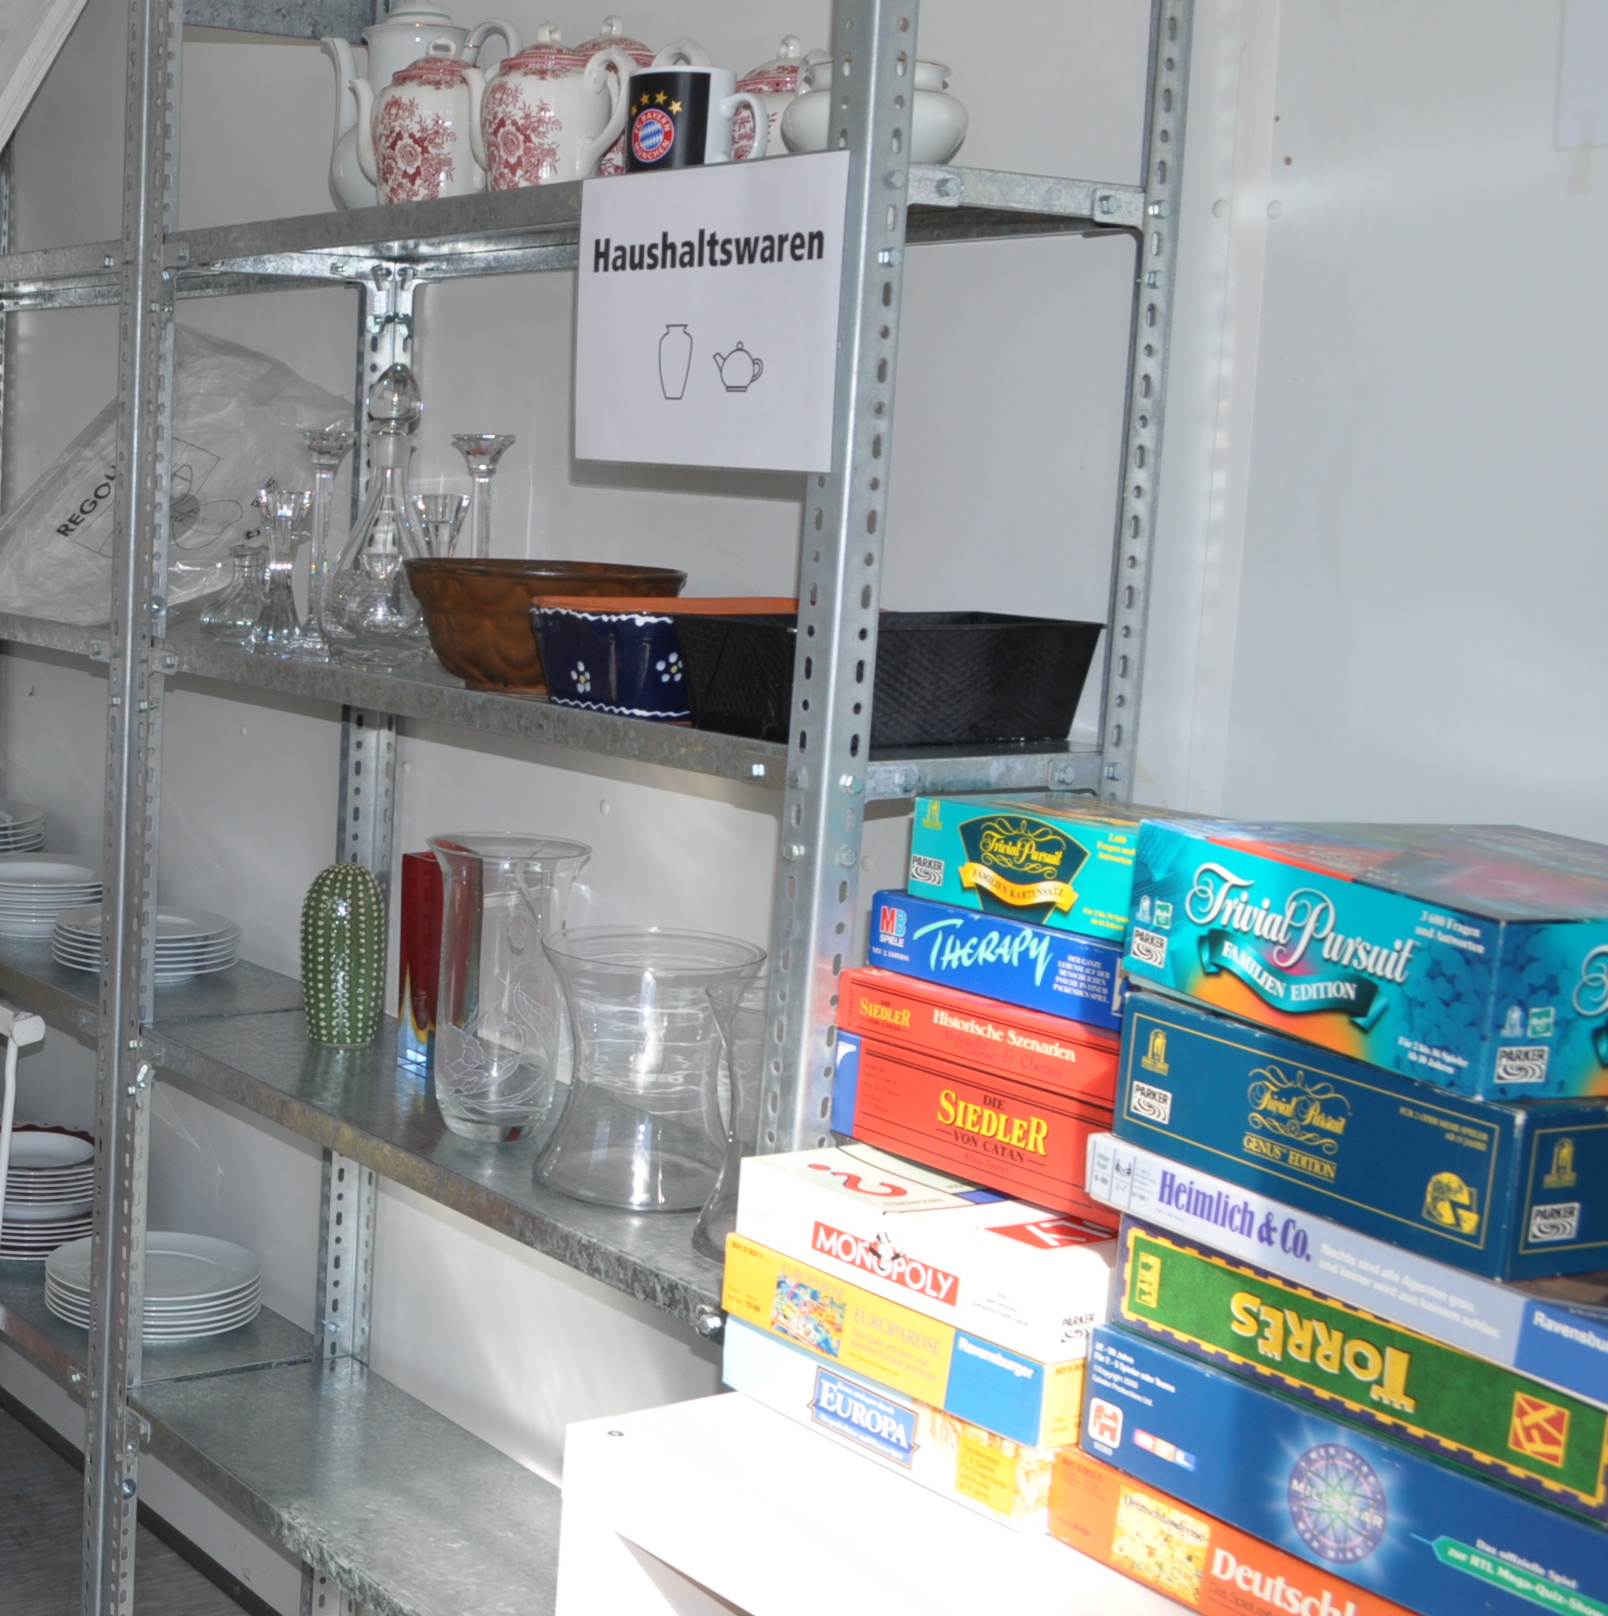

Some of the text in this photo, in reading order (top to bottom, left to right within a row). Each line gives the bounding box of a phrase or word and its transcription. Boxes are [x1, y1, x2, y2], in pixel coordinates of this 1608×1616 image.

[641, 110, 671, 132] BAYERN
[634, 140, 670, 161] MÜNCHEN
[594, 229, 824, 273] Haushaltswaren
[912, 856, 942, 871] PARKER
[980, 830, 1063, 870] Trivial Pursuit
[972, 869, 1064, 900] FAMILIEN KARTENSATZ
[880, 906, 907, 937] MB
[1133, 927, 1165, 950] PARKER
[1185, 862, 1414, 984] Trivial Pursuit
[879, 934, 905, 948] SPIELE
[912, 918, 1053, 987] THERAPY
[1222, 941, 1358, 1001] FAMILIEN EDITION
[860, 998, 911, 1028] SIEDLER
[933, 1009, 1076, 1062] Historische Szenarien
[1499, 1048, 1546, 1061] PARKER
[983, 1094, 1006, 1110] DIE
[1133, 1082, 1170, 1106] PARKER
[1248, 1080, 1294, 1117] Trivial
[937, 1090, 1048, 1156] SIEDLER
[953, 1130, 1026, 1163] VON CATAN
[1242, 1134, 1337, 1180] GENUS EDITION
[1158, 1169, 1312, 1262] Heimlich & Co.
[1533, 1206, 1578, 1224] PARKER
[816, 1226, 954, 1301] MONOPOLY
[1318, 1259, 1339, 1274] und
[1321, 1243, 1356, 1267] Nachts
[1358, 1256, 1380, 1275] sind
[1381, 1264, 1401, 1282] alle
[1402, 1276, 1448, 1301] Agenten
[853, 1307, 942, 1357] EUROPAREISE
[1061, 1314, 1096, 1328] PARKER
[1533, 1310, 1608, 1351] Ravensbu
[957, 1336, 1036, 1380] Ravensburger
[1229, 1291, 1418, 1414] TORRES
[819, 1379, 909, 1448] EUROPA
[1448, 1547, 1469, 1564] zur
[1469, 1554, 1496, 1575] RTL
[1476, 1538, 1498, 1555] Das
[1545, 1569, 1579, 1590] Spiel
